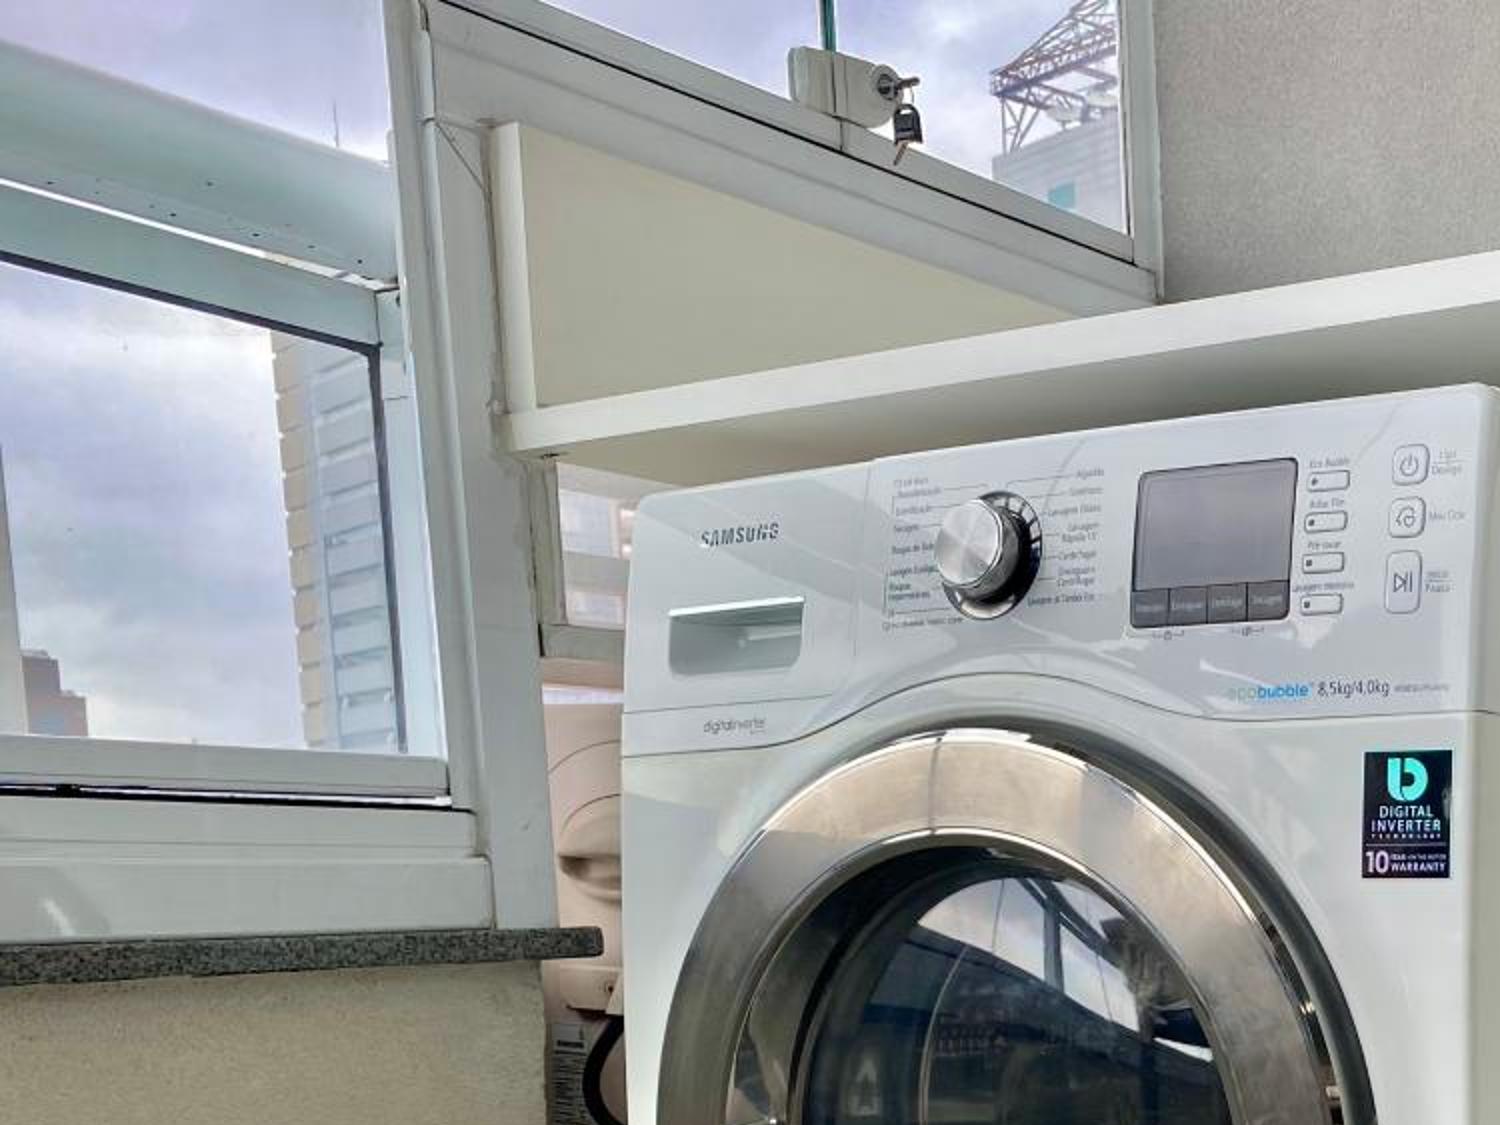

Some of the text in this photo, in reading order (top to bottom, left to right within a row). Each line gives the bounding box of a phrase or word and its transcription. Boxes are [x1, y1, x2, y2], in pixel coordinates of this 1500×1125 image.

[701, 522, 780, 547] SAMSUNG
[1317, 679, 1390, 698] 8,5kg/4,0kg
[1379, 805, 1434, 819] DIGITAL
[1371, 819, 1441, 832] INVERTER
[1365, 850, 1390, 874] 10
[1391, 861, 1447, 872] WARRANTY
